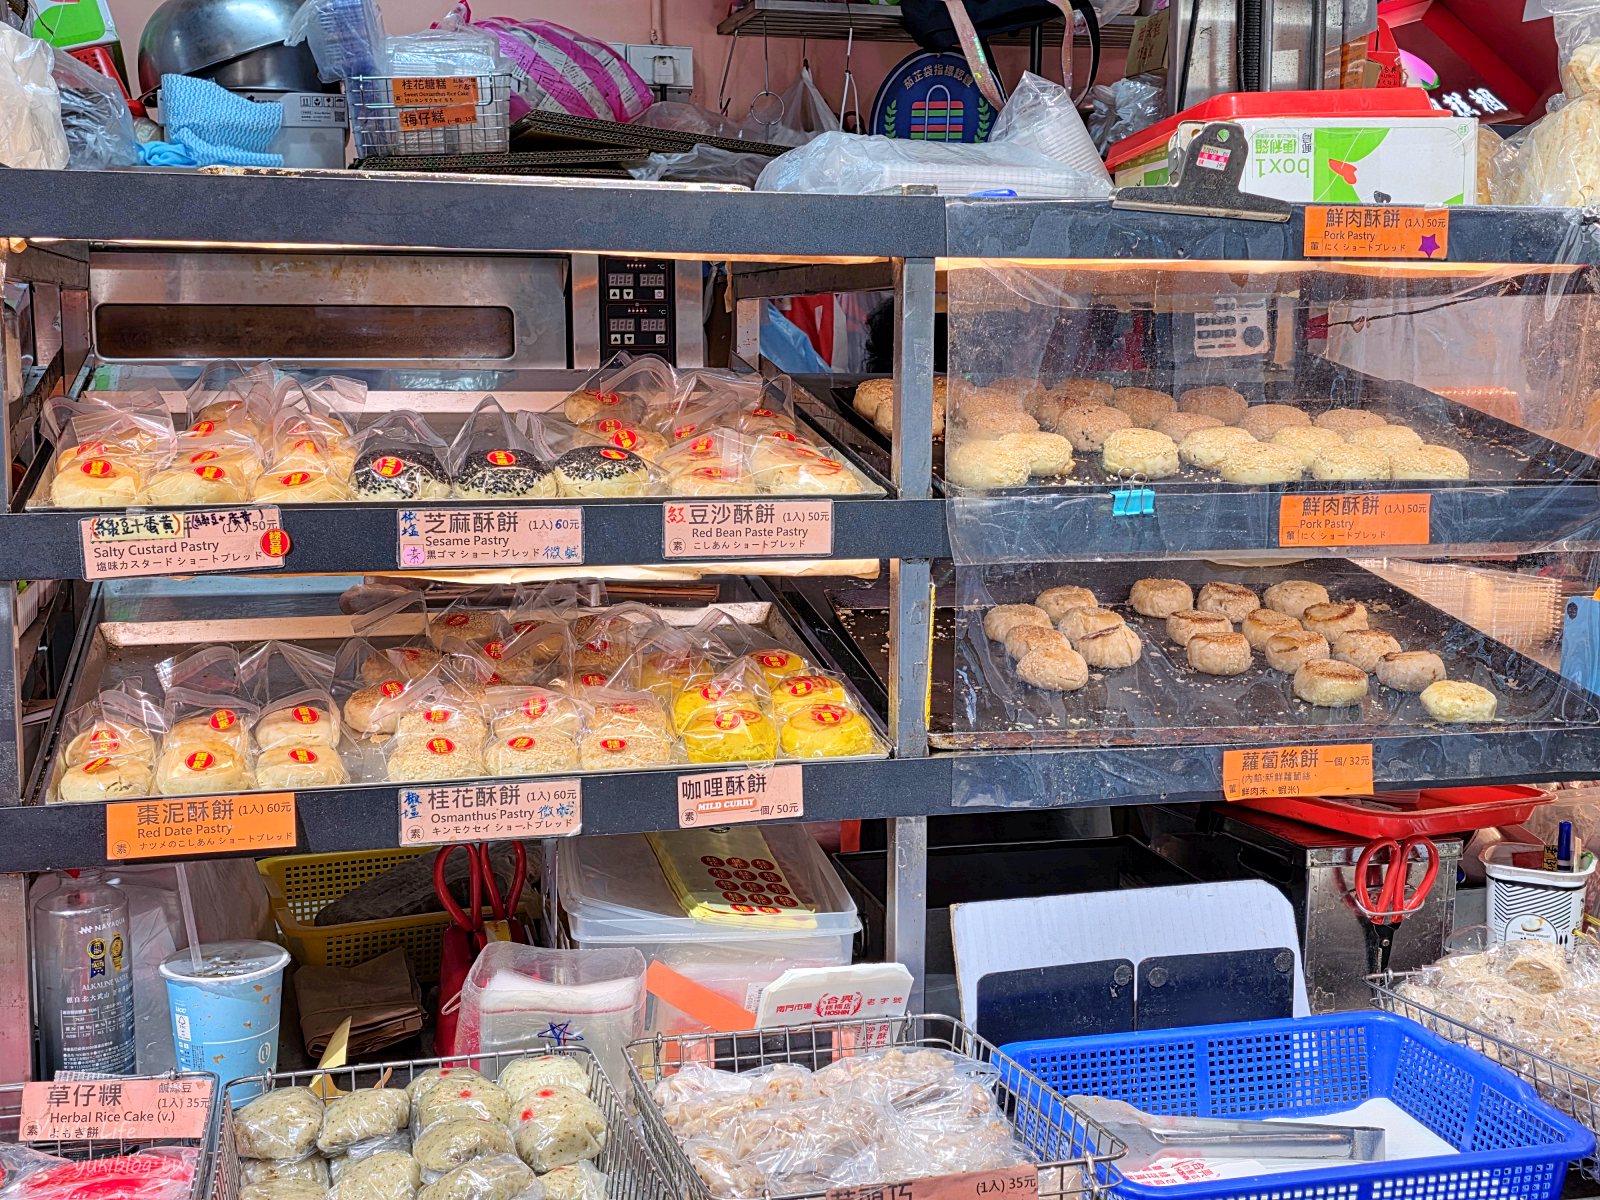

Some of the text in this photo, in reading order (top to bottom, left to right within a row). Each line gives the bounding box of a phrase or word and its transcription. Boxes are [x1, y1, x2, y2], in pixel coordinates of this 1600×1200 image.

[1256, 158, 1309, 178] box1
[1326, 208, 1400, 228] 鮮肉酥餅
[1427, 218, 1446, 228] 50元
[1324, 231, 1375, 242] Pork Pastry
[1302, 496, 1379, 516] 鮮肉酥餅
[1408, 503, 1426, 513] 50元
[689, 504, 775, 525] 豆沙酥餅
[808, 511, 829, 521] 50元
[424, 511, 518, 533] 芝麻酥餅
[555, 519, 579, 530] 60元
[1300, 519, 1354, 530] Pork Pastry
[692, 527, 808, 538] Red Bean Paste Pastry
[426, 535, 509, 547] Sesame Pastry
[673, 541, 682, 551] 素
[694, 540, 805, 549] こしあん ショートブレッド
[94, 541, 219, 559] Salty Custard Pastry
[461, 548, 540, 558] ショートブレッド
[96, 551, 263, 571] 塩味カスタード ショートブレッド
[1242, 749, 1318, 771] 蘿蔔絲餅
[1350, 756, 1370, 766] 32元
[681, 773, 767, 800] 咖哩酥餅
[428, 785, 520, 810] 桂花酥餅
[553, 789, 577, 800] 60元
[698, 798, 755, 811] MILD CURRY
[777, 803, 799, 814] 50元
[137, 799, 234, 825] 棗泥酥餅
[267, 801, 291, 813] 60元
[431, 808, 535, 823] Osmanthus Pastry
[685, 811, 694, 821] 素
[137, 824, 232, 838] Red Date Pastry
[410, 829, 420, 839] 素
[432, 824, 489, 835] キンモクセイ
[139, 832, 293, 850] ナツメのこしあん ショートブレッド
[82, 979, 114, 991] ALKALINE
[776, 1002, 812, 1013] 南門市場
[47, 1083, 122, 1107] 草仔粿
[186, 1097, 209, 1108] 35元
[50, 1110, 175, 1123] Herbal Rice Cake (v.)
[27, 1125, 38, 1136] 素
[1008, 1175, 1036, 1189] 35元
